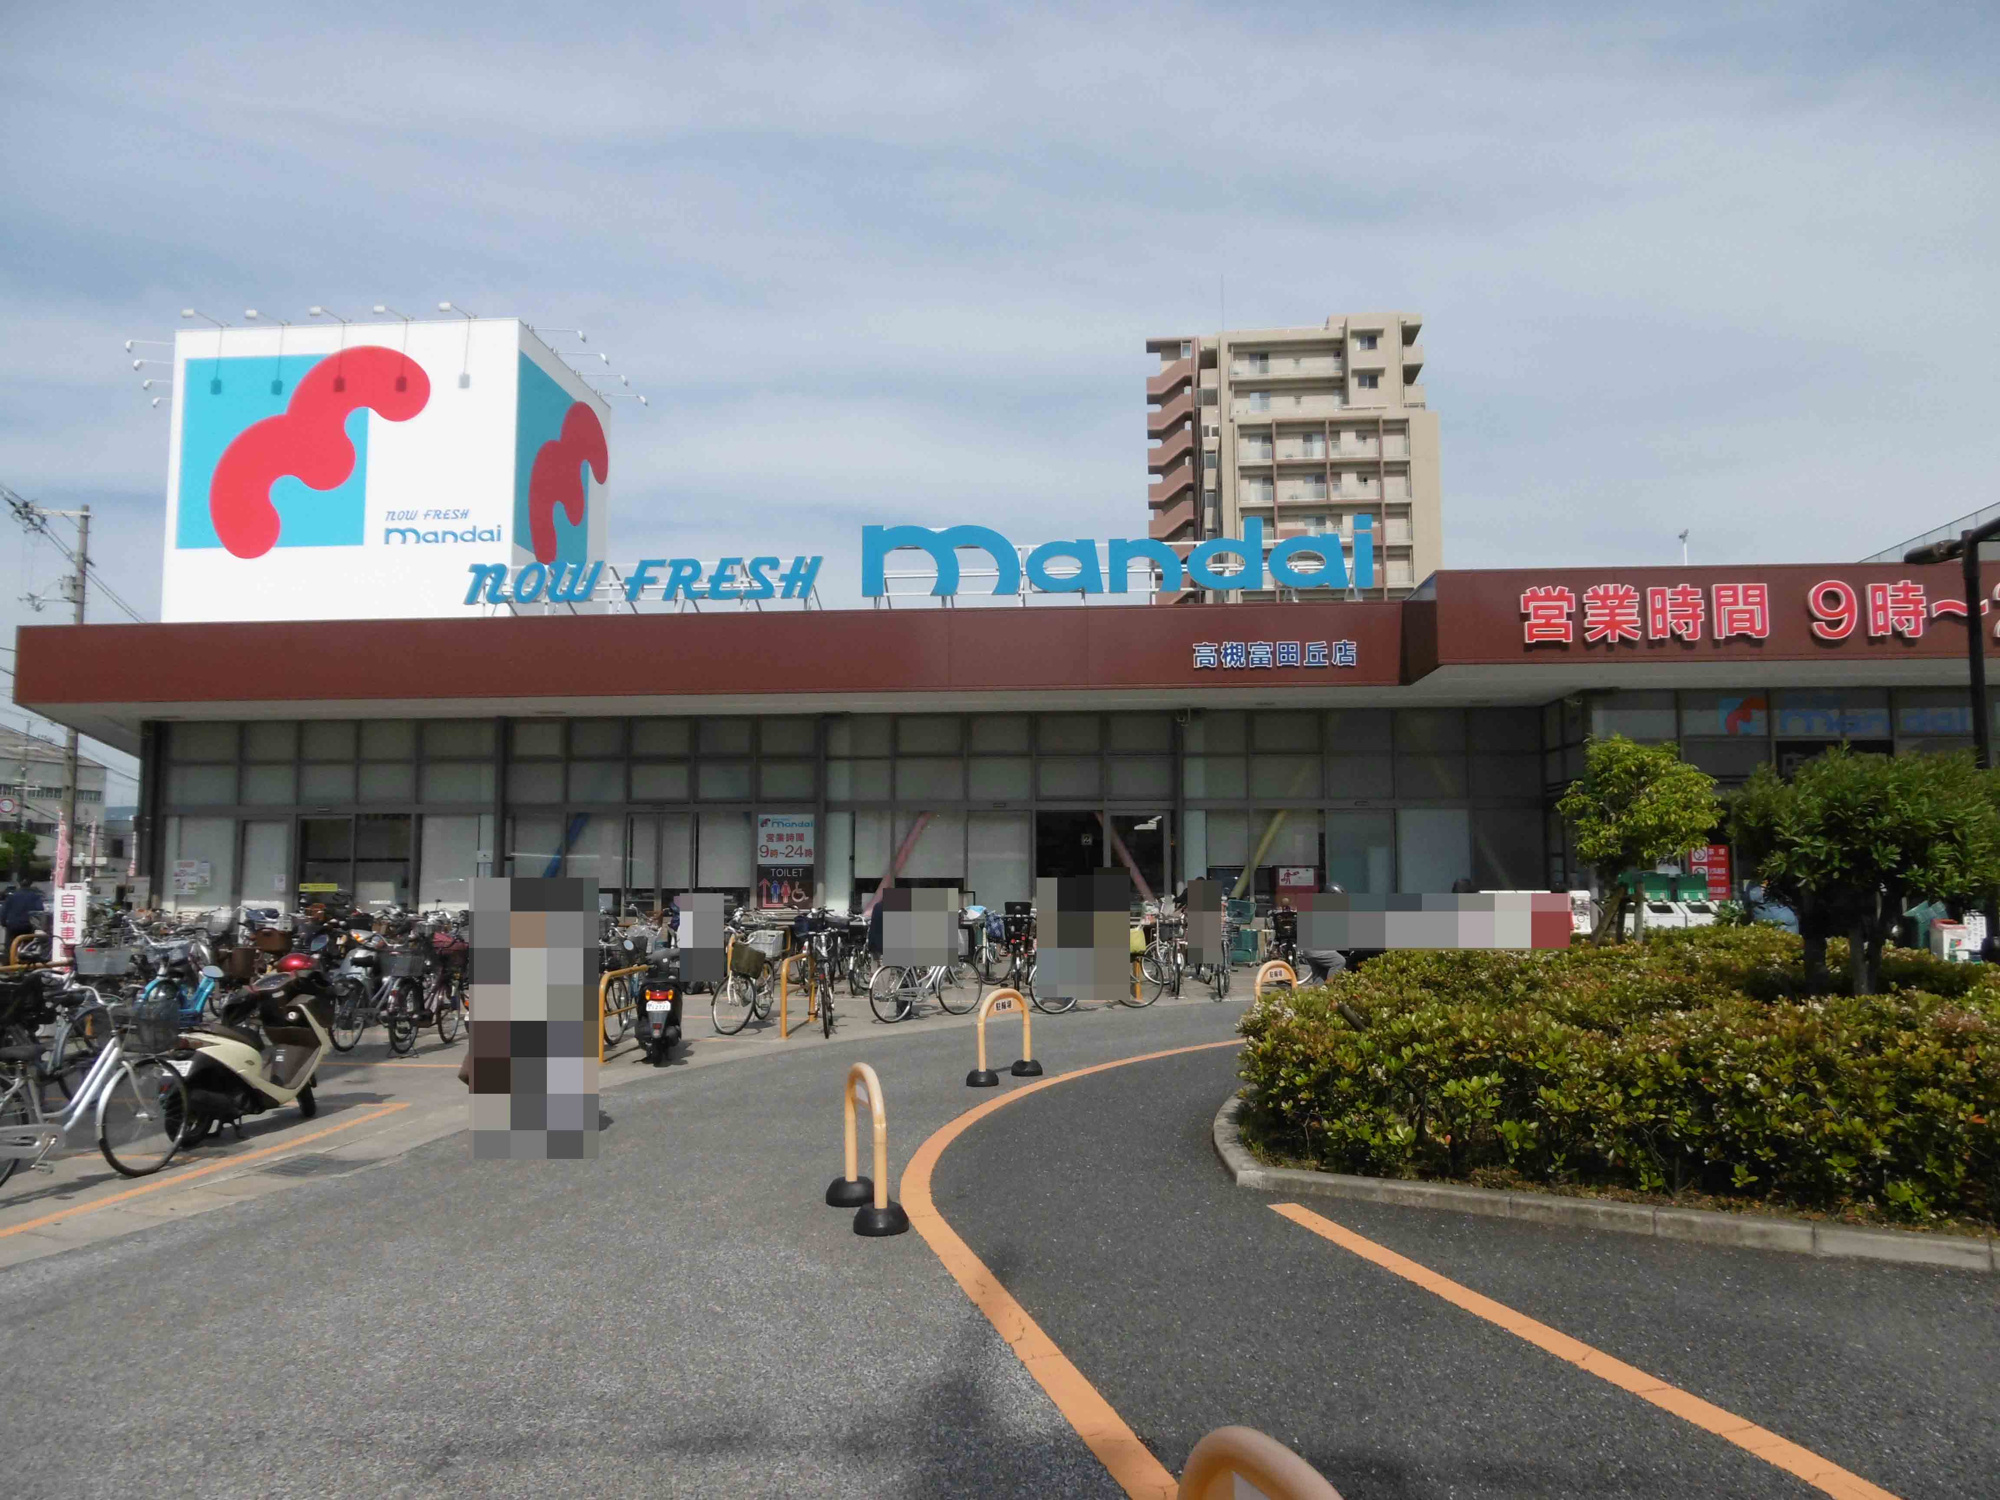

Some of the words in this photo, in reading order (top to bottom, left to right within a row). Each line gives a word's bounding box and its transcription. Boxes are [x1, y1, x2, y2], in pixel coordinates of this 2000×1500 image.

[423, 508, 470, 520] FRESH
[384, 524, 501, 545] mandai
[623, 556, 824, 601] FRESH
[862, 514, 1374, 597] mandai
[1520, 583, 1769, 643] 営業時間
[1807, 579, 2000, 640] 9時～
[1193, 640, 1357, 668] 高槻富田丘店
[771, 820, 813, 828] mandai
[766, 833, 805, 842] 営業時間
[770, 868, 804, 877] TOILET
